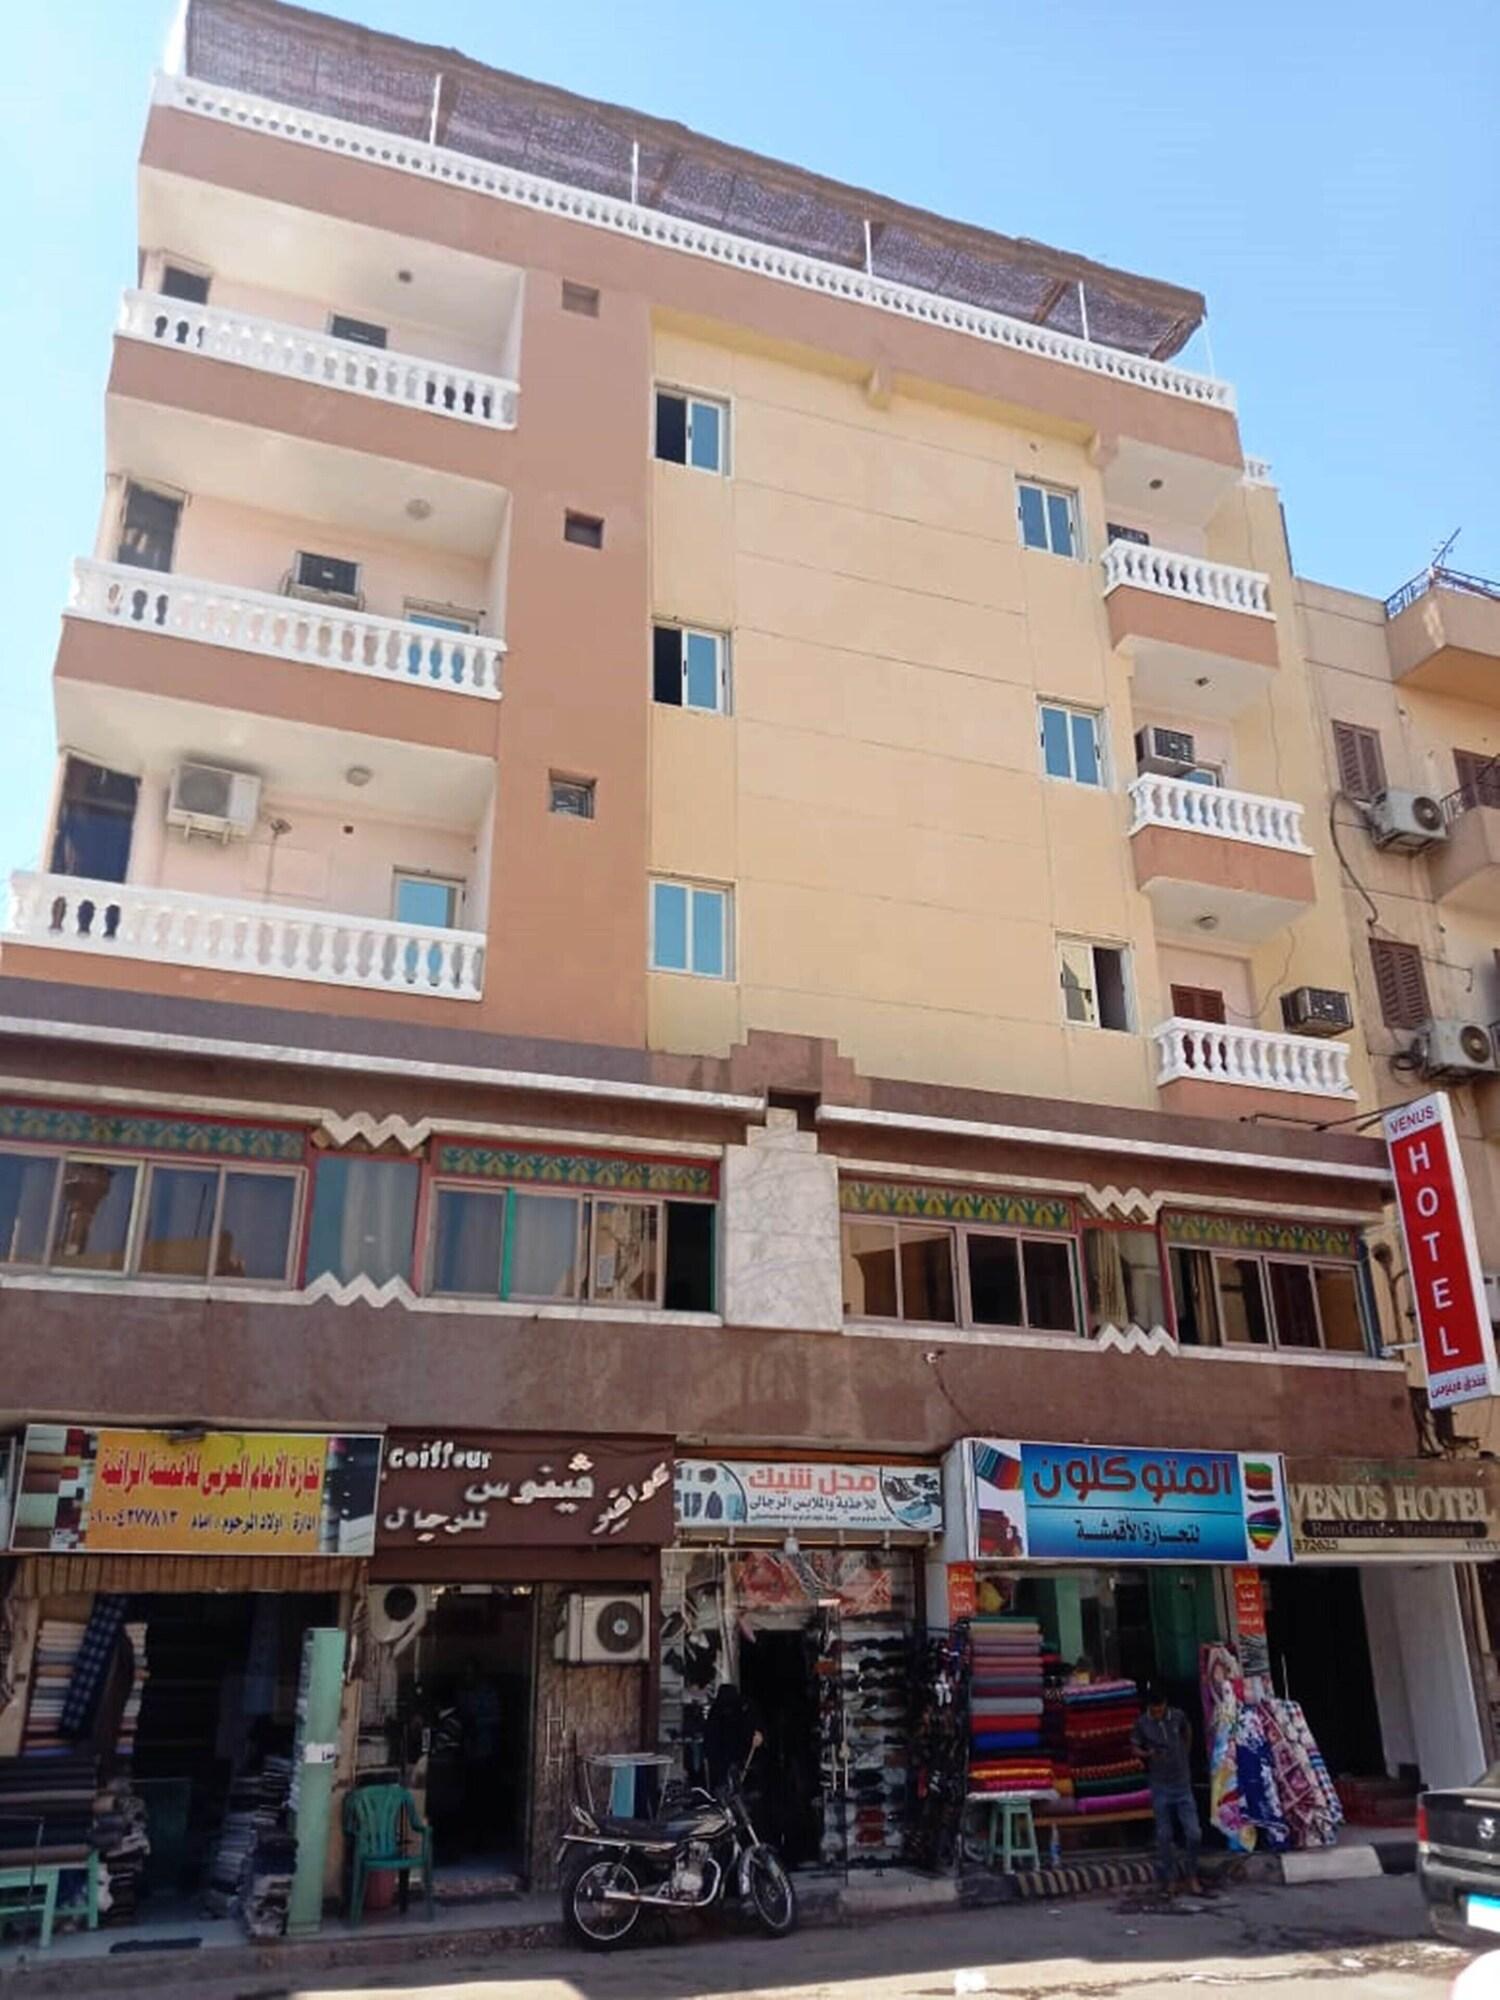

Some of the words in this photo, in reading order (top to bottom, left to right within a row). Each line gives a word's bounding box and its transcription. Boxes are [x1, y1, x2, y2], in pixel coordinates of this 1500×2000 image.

[1389, 1105, 1435, 1134] VENUS
[1408, 1140, 1460, 1357] HOTEL
[1463, 1372, 1487, 1392] فندق
[388, 1441, 492, 1469] Coiffeur
[749, 1466, 812, 1495] شيك
[818, 1469, 876, 1496] محل
[1033, 1455, 1232, 1505] المتوكلون
[1288, 1484, 1387, 1521] VENUS
[1393, 1485, 1496, 1522] HOTEL
[384, 1507, 489, 1542] للرجال
